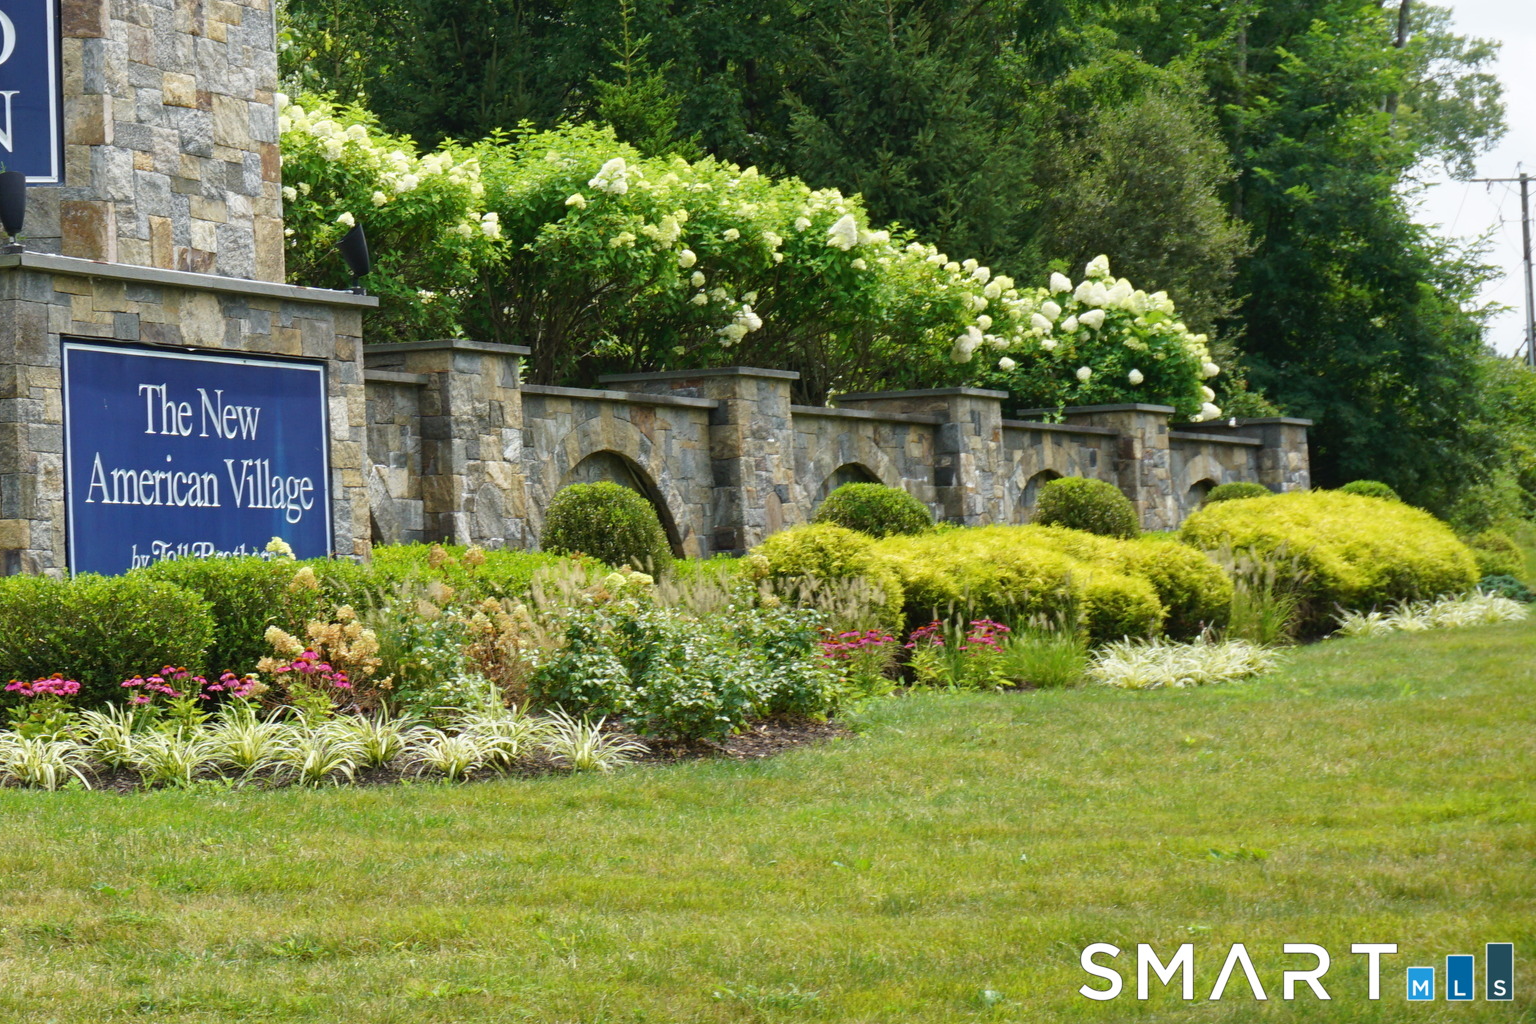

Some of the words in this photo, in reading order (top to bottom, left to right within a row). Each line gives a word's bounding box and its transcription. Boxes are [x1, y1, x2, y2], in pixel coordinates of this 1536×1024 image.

[138, 382, 193, 437] The
[196, 388, 261, 441] New
[84, 451, 222, 508] American
[223, 457, 314, 524] Village
